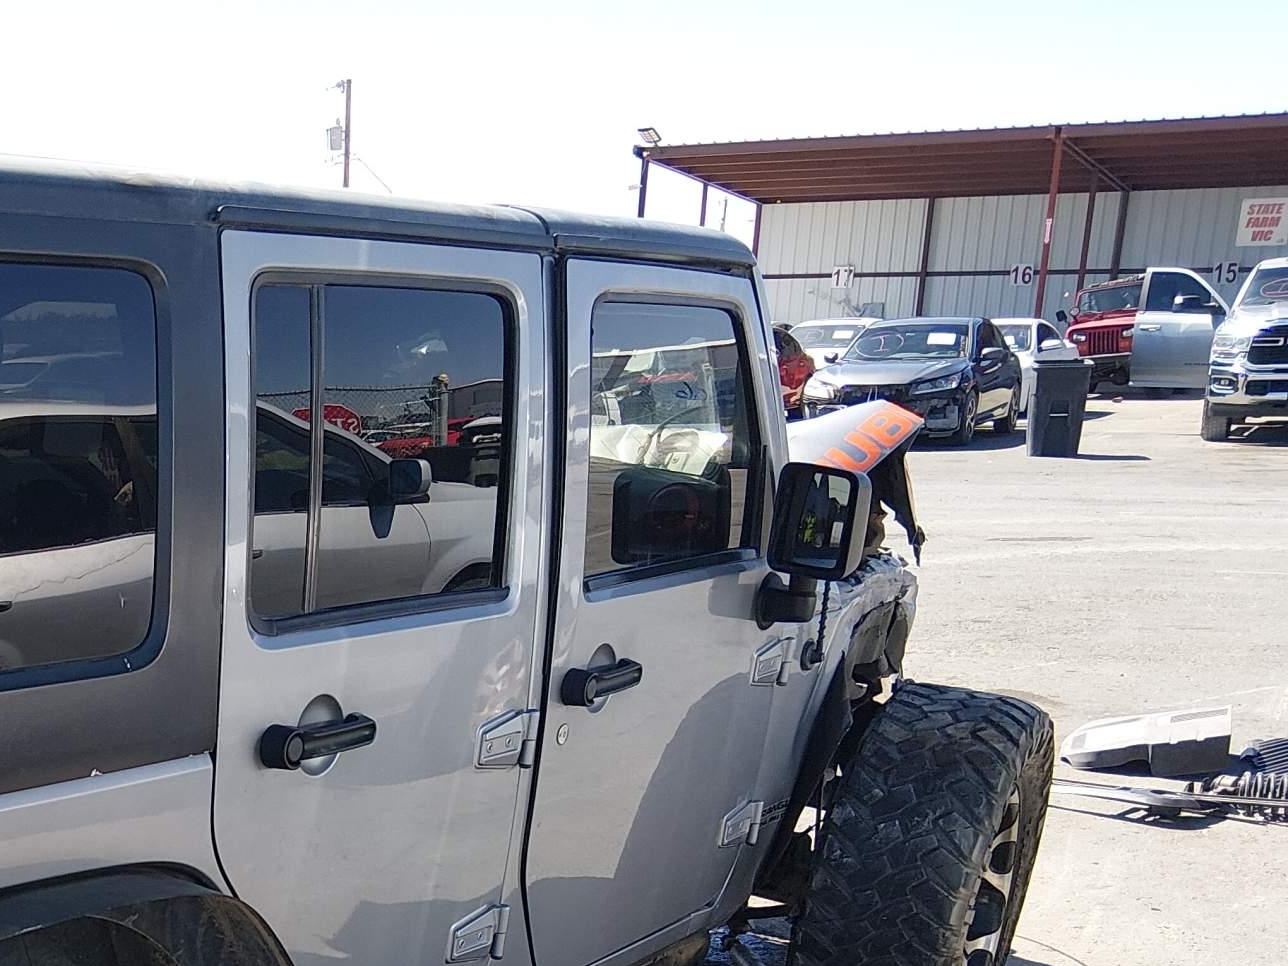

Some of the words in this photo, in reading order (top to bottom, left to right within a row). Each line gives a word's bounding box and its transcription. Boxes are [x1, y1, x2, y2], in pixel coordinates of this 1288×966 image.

[1247, 203, 1285, 215] STATE
[1245, 216, 1281, 228] FARM
[1251, 230, 1274, 241] VIC
[833, 268, 854, 287] 17
[1012, 265, 1032, 285] 16
[1215, 263, 1237, 283] 15
